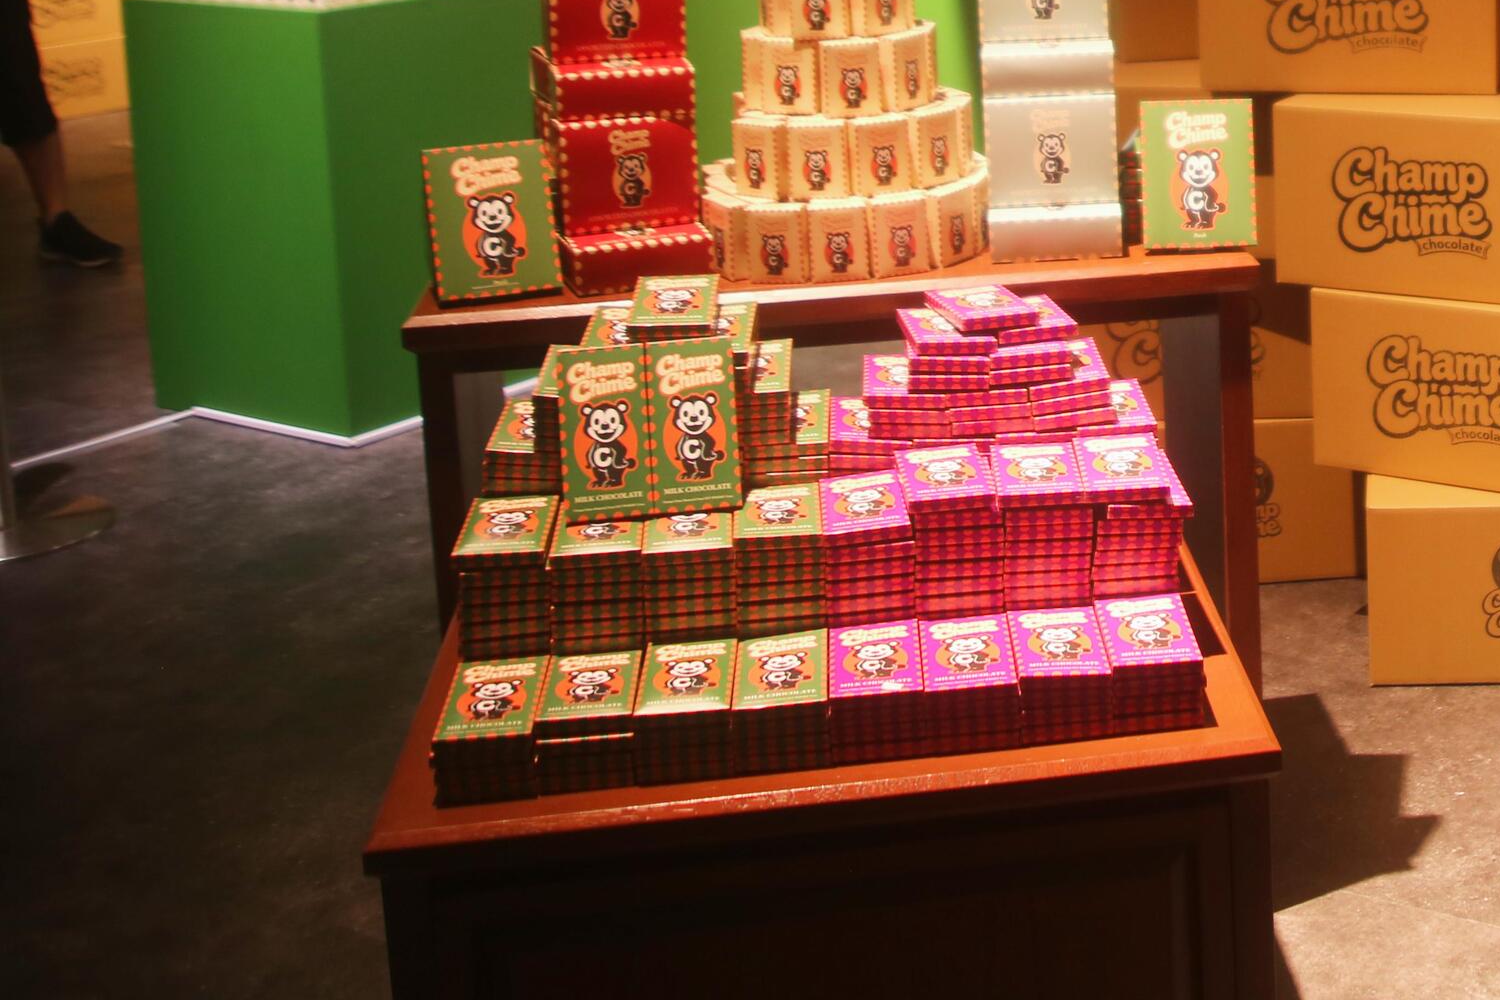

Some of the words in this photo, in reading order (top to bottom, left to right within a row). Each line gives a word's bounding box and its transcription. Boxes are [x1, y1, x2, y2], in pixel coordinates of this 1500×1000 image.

[1356, 34, 1420, 50] chocolate
[1332, 147, 1488, 201] Champ
[1338, 193, 1492, 253] Chime
[1422, 237, 1484, 253] chocolate
[566, 361, 636, 386] Champ
[655, 353, 724, 378] Champ
[569, 376, 638, 404] Chime
[658, 368, 726, 396] Chime
[573, 495, 595, 504] MILK
[595, 490, 643, 502] CHOCOLATE
[663, 486, 684, 495] MILK
[685, 482, 732, 493] CHOCOLATE
